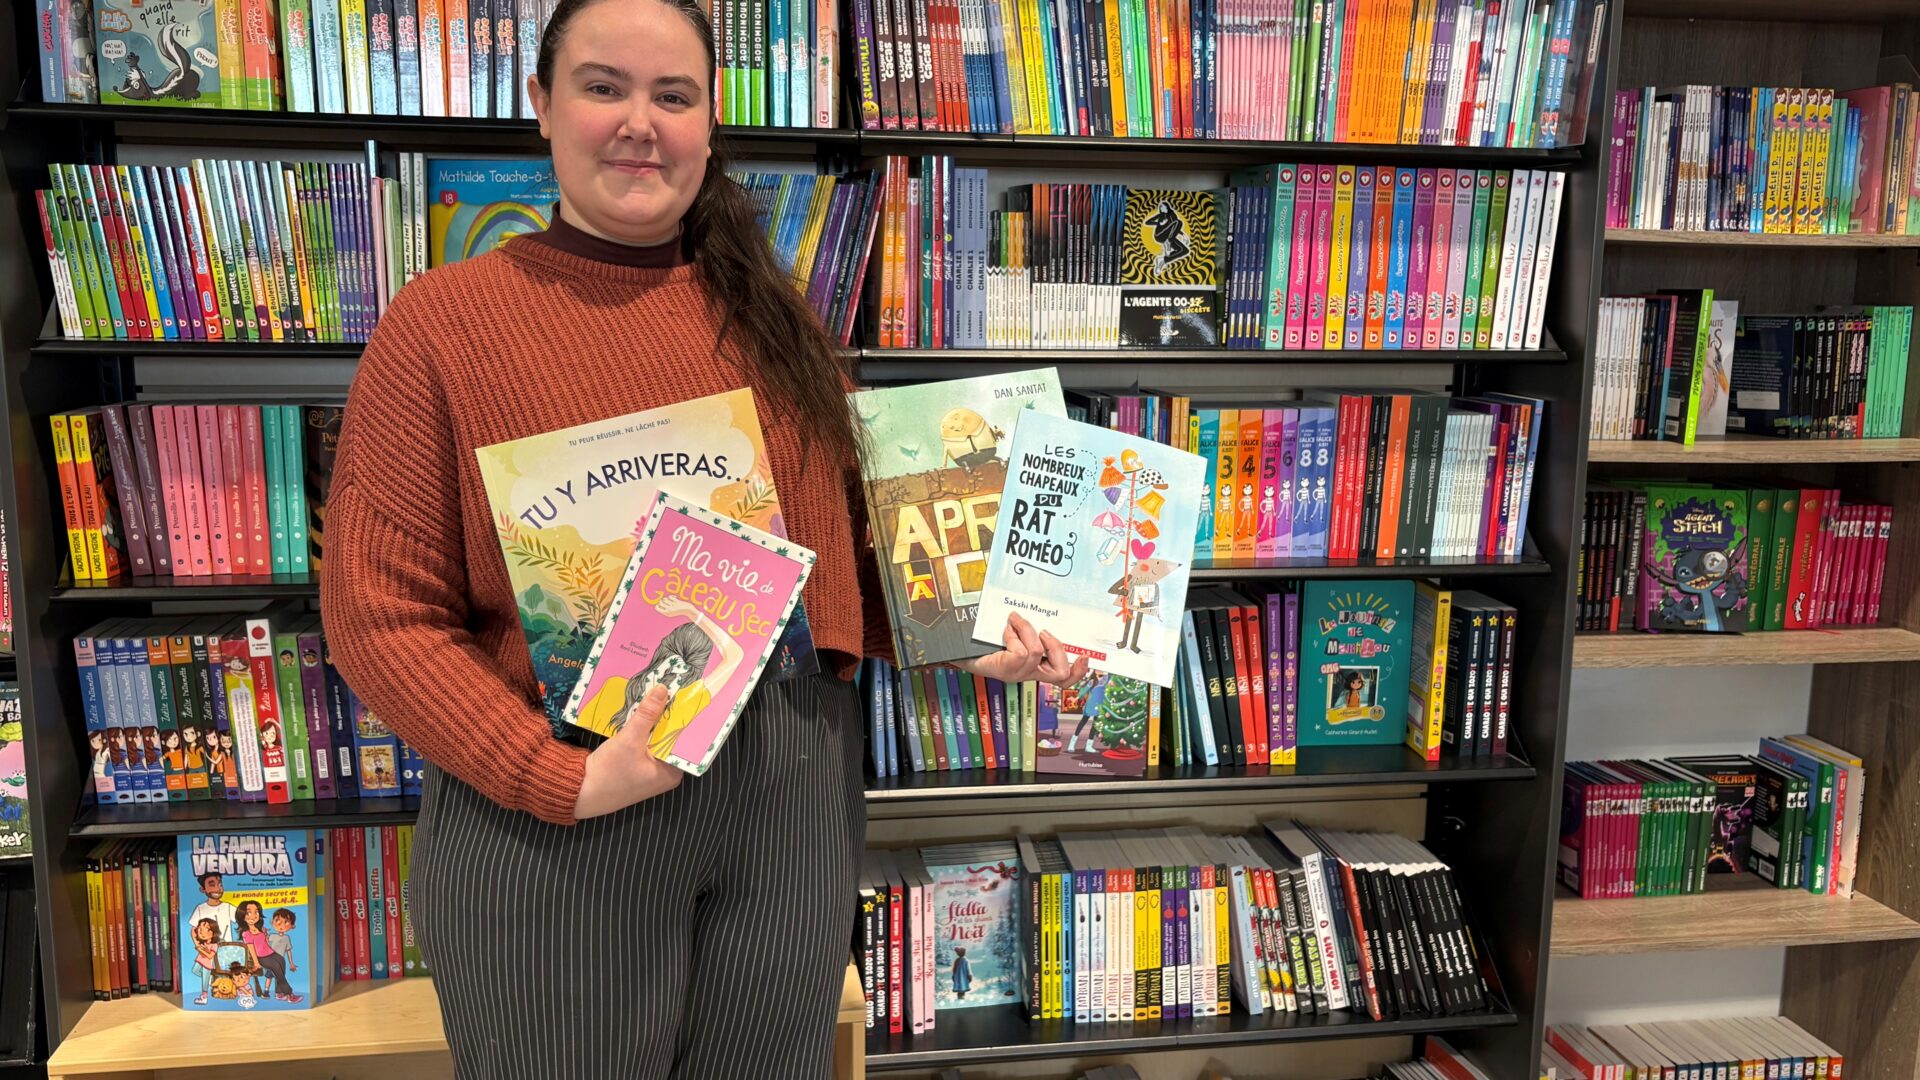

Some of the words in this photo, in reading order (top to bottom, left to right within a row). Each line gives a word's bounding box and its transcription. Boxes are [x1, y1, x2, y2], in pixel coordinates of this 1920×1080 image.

[140, 2, 173, 27] quand
[156, 12, 176, 25] elle
[175, 25, 191, 38] rit
[859, 37, 873, 100] SLIMEVILLE
[884, 42, 894, 78] Cacas
[903, 42, 913, 78] Cacas
[923, 44, 933, 79] Cacas
[440, 170, 485, 183] Mathilde
[1768, 171, 1778, 202] AMÉLIE
[1783, 171, 1792, 202] AMÉLIE
[1800, 171, 1809, 202] AMÉLIE
[1814, 172, 1823, 203] AMÉLIE
[445, 194, 454, 204] 18
[211, 243, 222, 269] Pablito
[222, 240, 234, 264] Pablito
[234, 239, 246, 265] Pablito
[247, 240, 259, 265] Pablito
[260, 247, 272, 272] Pablito
[217, 277, 228, 307] Boulette
[228, 273, 240, 305] Boulette
[240, 273, 251, 305] Boulette
[253, 273, 264, 305] Boulette
[266, 280, 277, 310] Boulette
[278, 275, 288, 307] Boulette
[1124, 296, 1172, 307] L'AGENTE
[994, 387, 1013, 399] DAN
[1016, 383, 1047, 397] SANTAT
[579, 435, 595, 446] PEUX
[635, 421, 656, 431] LÂCHE
[656, 417, 671, 428] PAS!
[1045, 444, 1075, 459] LES
[1282, 451, 1293, 467] 6
[1300, 449, 1312, 467] 8
[1316, 448, 1328, 466] 8
[1393, 439, 1401, 461] L'ÉCOLE
[1023, 453, 1086, 481] NOMBREUX
[1220, 455, 1233, 479] 3
[1242, 454, 1255, 478] 4
[1263, 457, 1276, 479] 5
[1409, 459, 1417, 488] MYSTÈRES
[1428, 458, 1437, 488] MYSTÈRES
[520, 495, 558, 531] TU
[555, 480, 577, 505] Y
[586, 452, 750, 496] ARRIVERAS...
[1019, 471, 1080, 497] CHAPEAUX
[1390, 468, 1398, 497] MYSTÈRES
[1039, 495, 1059, 507] DU
[1502, 485, 1510, 506] BANDE
[68, 510, 77, 525] TOUS
[86, 510, 95, 525] TOUS
[893, 494, 1001, 565] APR
[1011, 499, 1056, 536] RAT
[1672, 519, 1723, 535] STITCH
[1685, 513, 1716, 521] AGENT
[72, 533, 81, 553] PIGEONS
[90, 533, 99, 553] PIGEONS
[74, 555, 83, 572] SACRÉS
[92, 555, 101, 572] SACRÉS
[672, 525, 714, 577] Ma
[718, 559, 759, 597] vie
[760, 580, 774, 595] de
[640, 567, 738, 622] Gâteau
[727, 602, 773, 638] Sec
[954, 608, 966, 622] LA
[1004, 597, 1029, 612] Sakshi
[1029, 603, 1059, 618] Mangal
[1063, 645, 1106, 660] HOLASTIC
[1320, 662, 1339, 674] OMG
[1209, 678, 1221, 697] NISH
[1225, 677, 1237, 696] NISH
[1238, 675, 1248, 695] NISH
[1253, 675, 1263, 694] NISH
[1464, 701, 1474, 739] CHARLOTTE
[1482, 701, 1492, 738] CHARLOTTE
[1498, 701, 1507, 739] CHARLOTTE
[218, 835, 286, 855] FAMILLE
[299, 851, 304, 860] 1
[191, 852, 293, 878] VENTURA
[264, 890, 287, 898] secret
[371, 868, 380, 899] Muffin
[373, 910, 383, 935] Drôle
[946, 900, 987, 923] Stella
[949, 923, 986, 940] Noël
[1323, 936, 1334, 959] LILY
[1329, 970, 1340, 990] MOI
[866, 989, 875, 1028] CHARLOTTE
[876, 979, 885, 1017] CHARLOTTE
[891, 979, 900, 1017] CHARLOTTE
